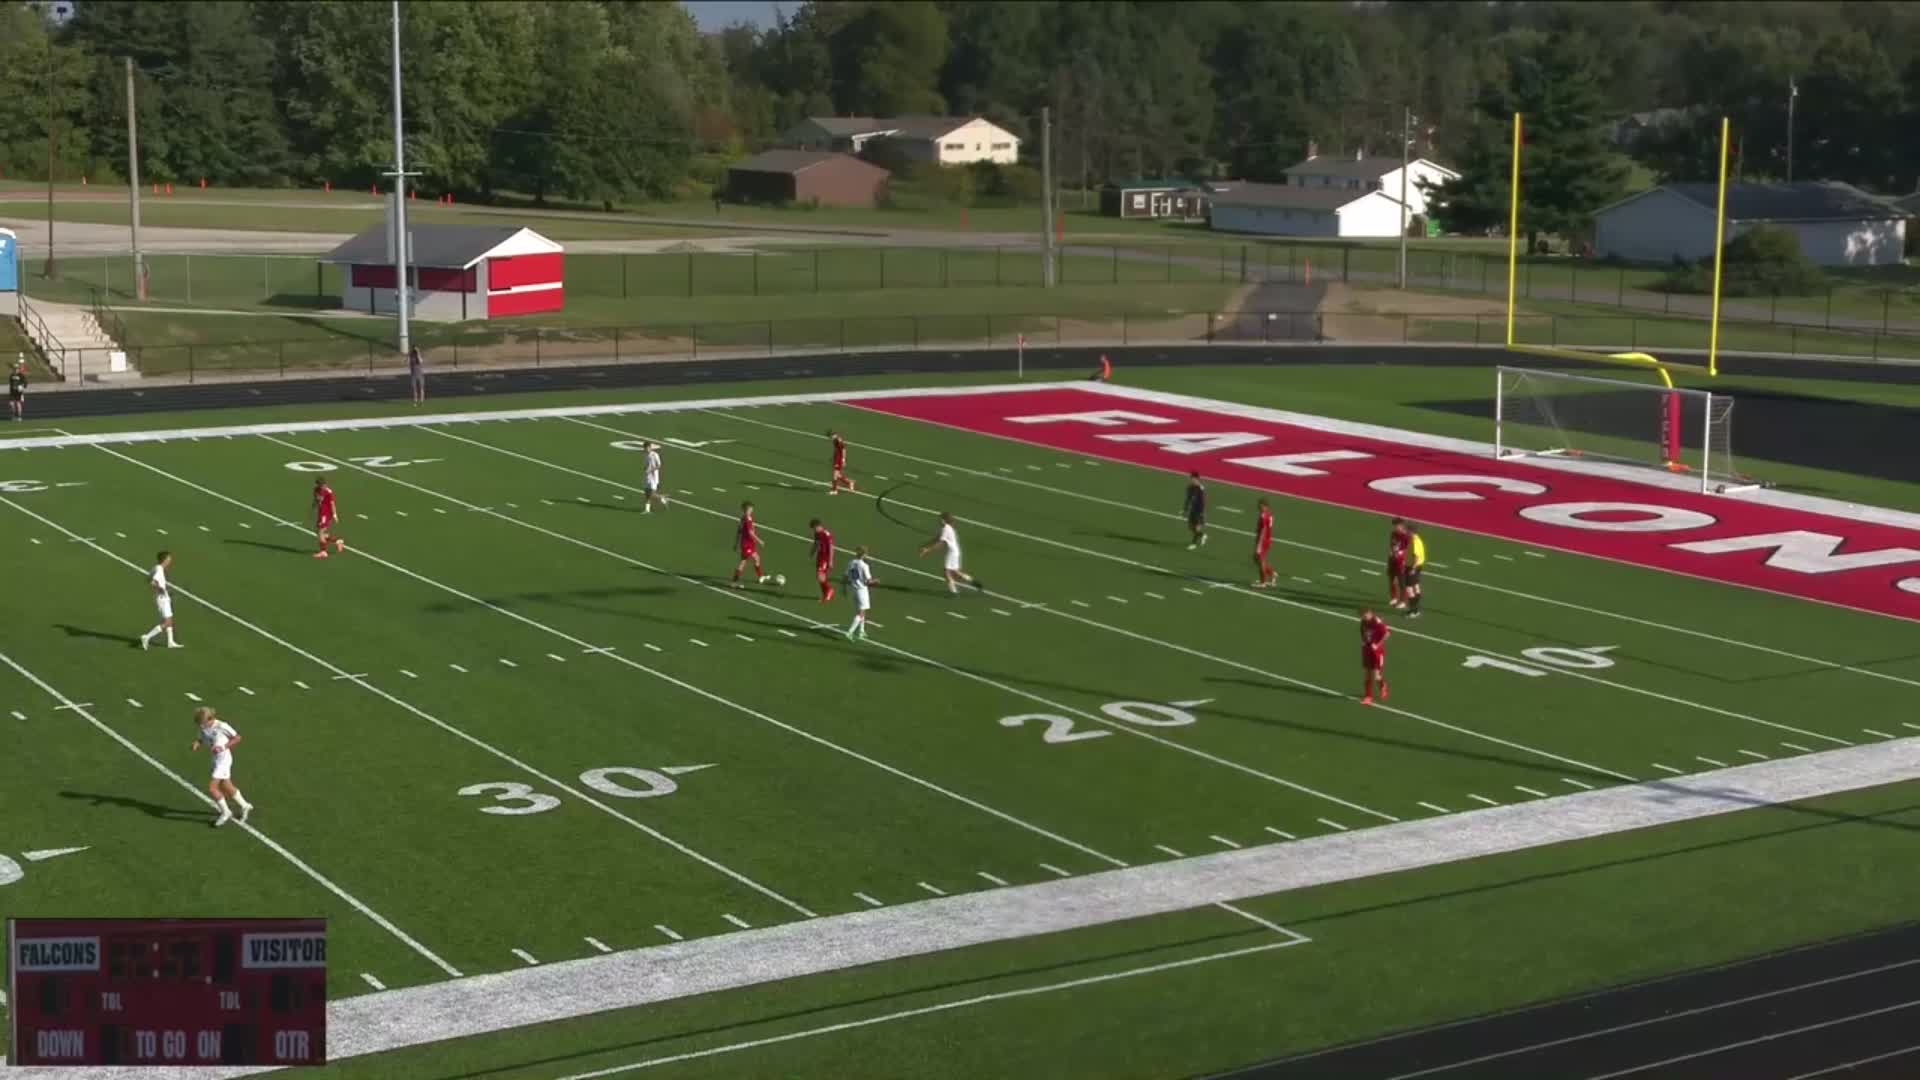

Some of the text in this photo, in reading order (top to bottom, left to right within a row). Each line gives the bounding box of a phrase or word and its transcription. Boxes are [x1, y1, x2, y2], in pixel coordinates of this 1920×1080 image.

[1001, 409, 1920, 596] FALCON
[1461, 647, 1615, 677] 10
[998, 701, 1196, 743] 20
[458, 766, 678, 815] 30
